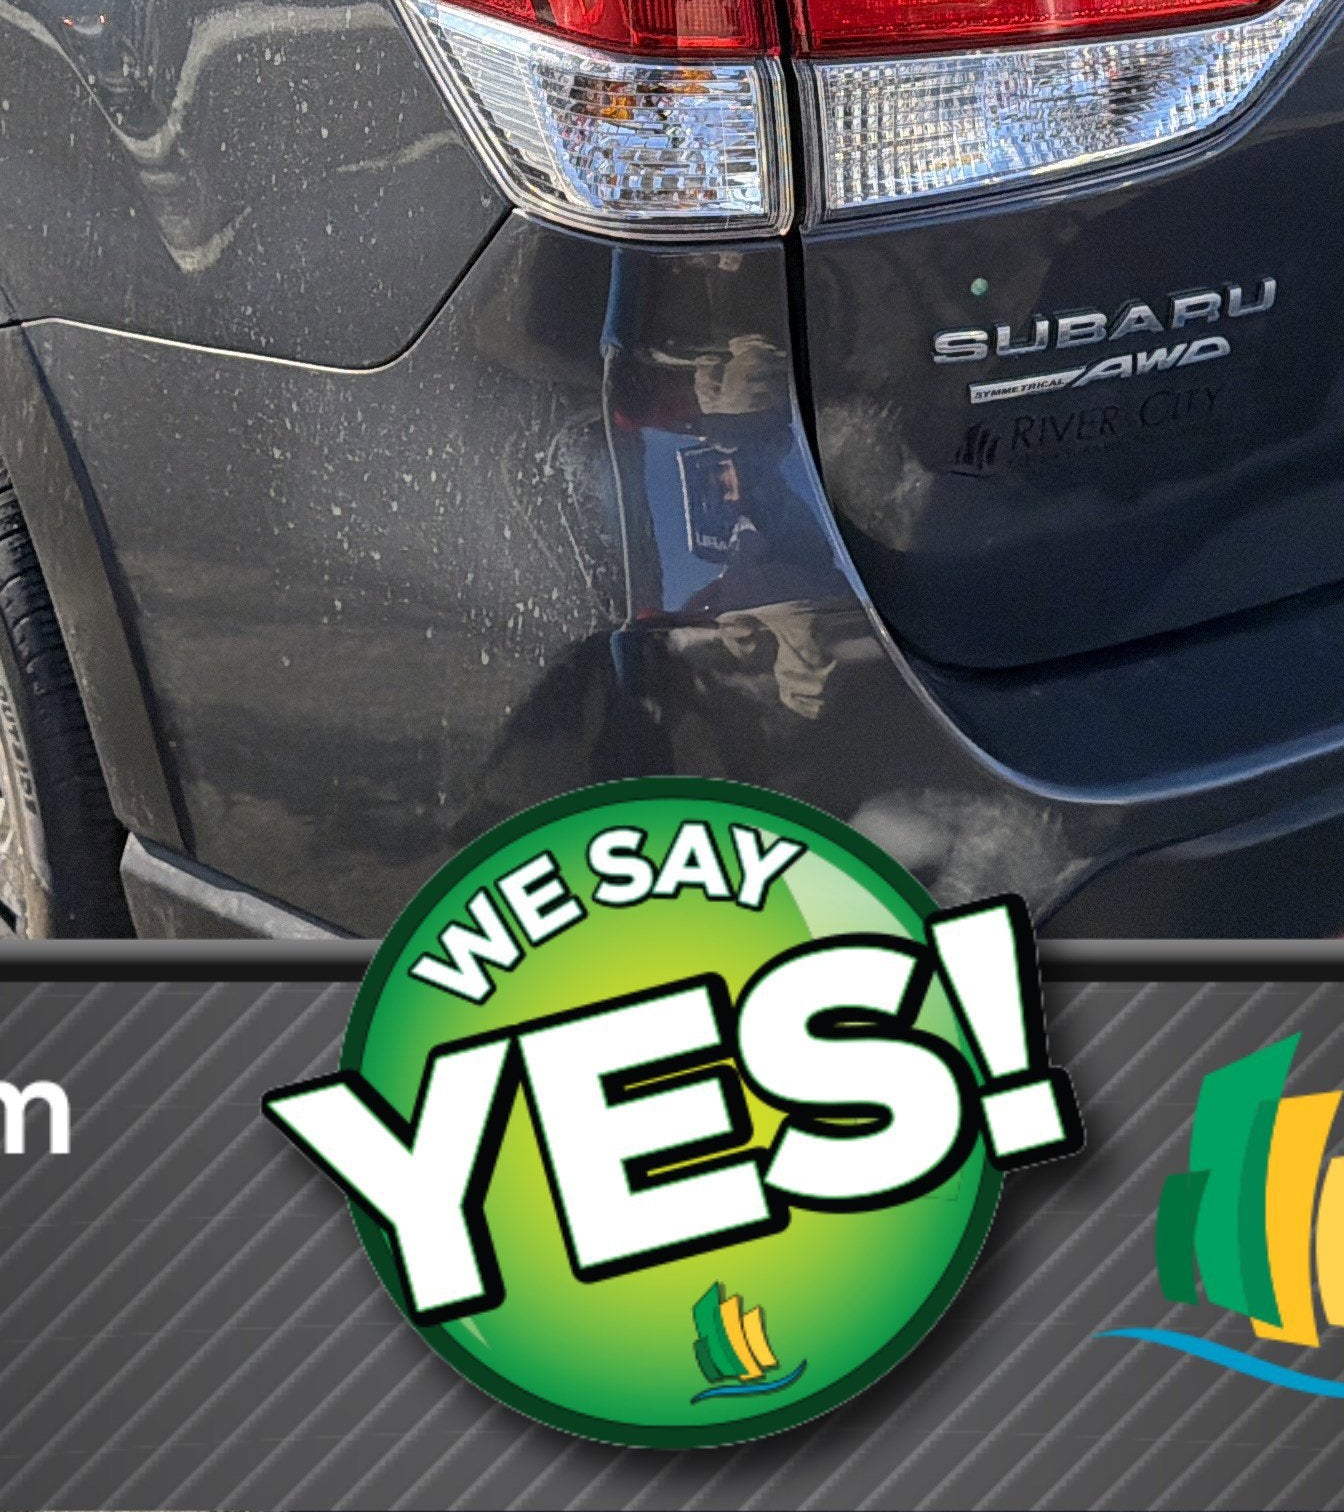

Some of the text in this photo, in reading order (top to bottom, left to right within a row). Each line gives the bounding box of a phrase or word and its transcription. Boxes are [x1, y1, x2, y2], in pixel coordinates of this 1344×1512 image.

[932, 276, 1277, 365] SUBARU
[973, 335, 1233, 401] SYMMETRICAL AWD
